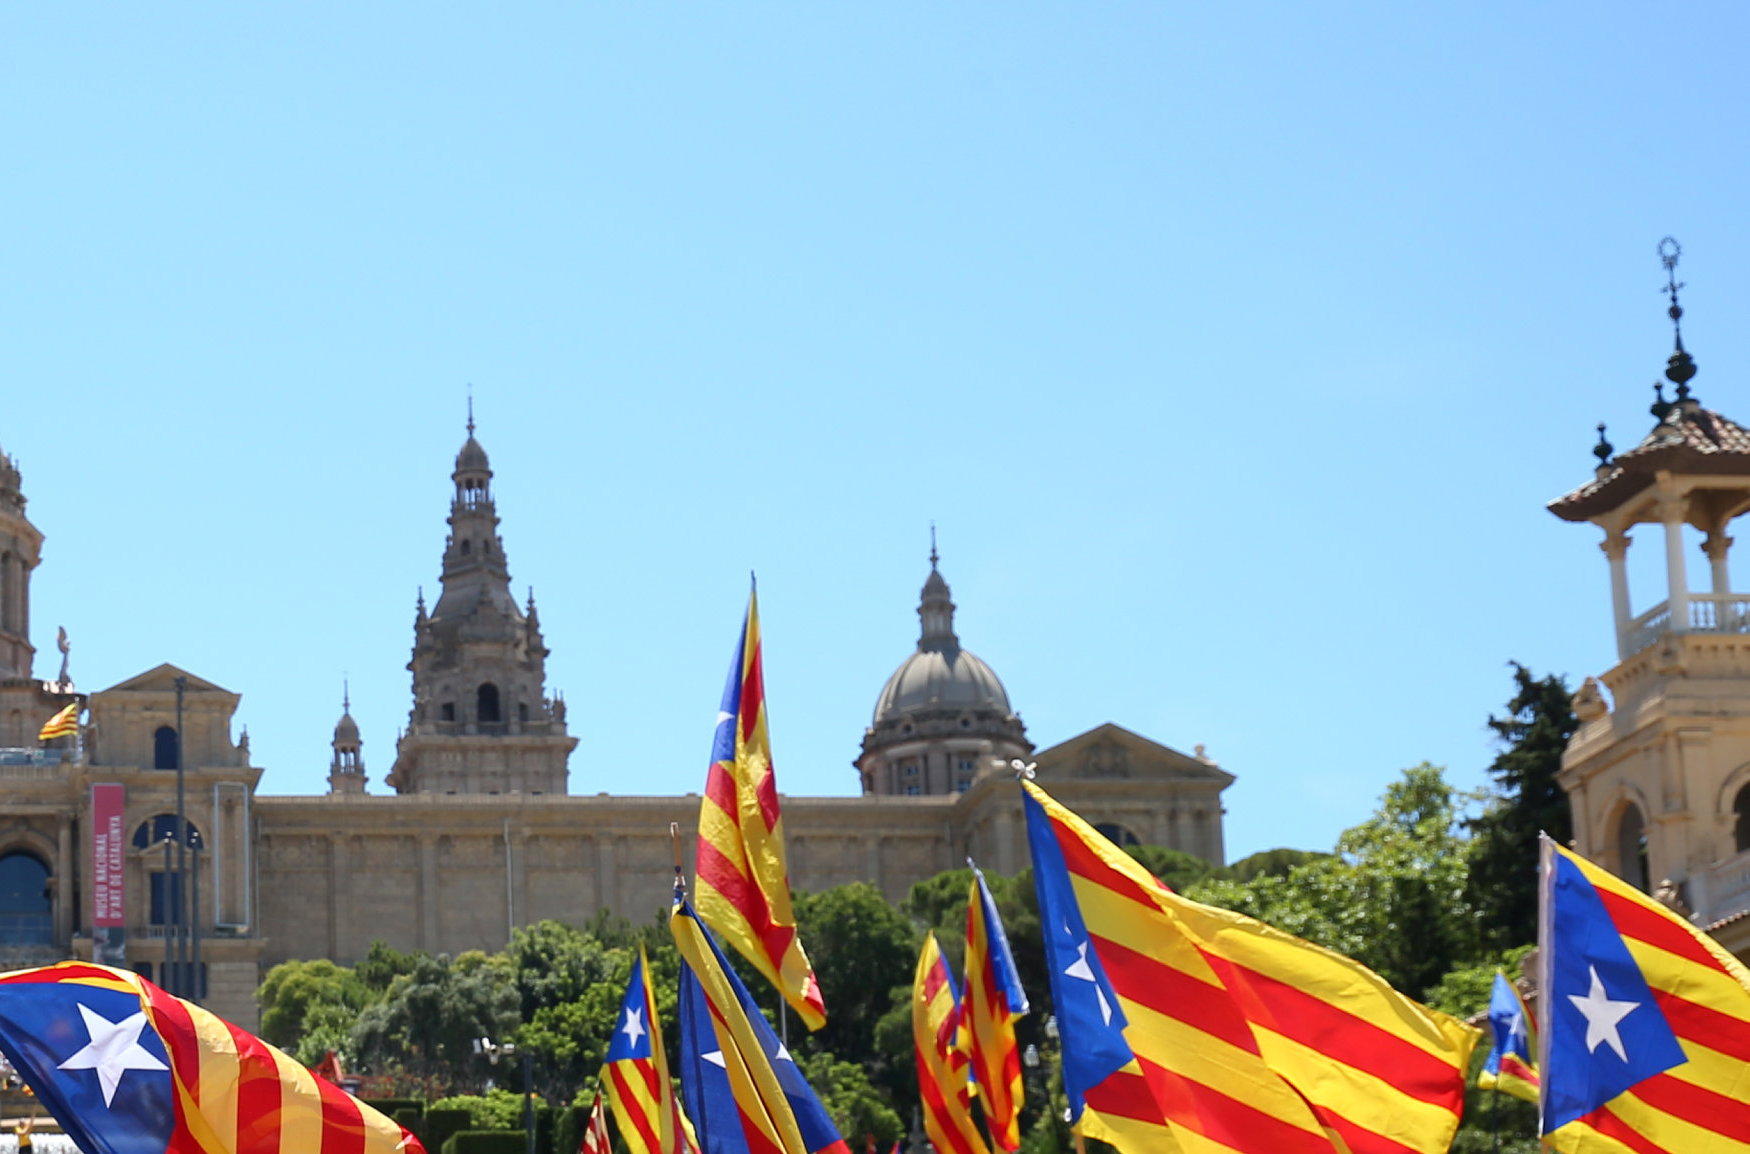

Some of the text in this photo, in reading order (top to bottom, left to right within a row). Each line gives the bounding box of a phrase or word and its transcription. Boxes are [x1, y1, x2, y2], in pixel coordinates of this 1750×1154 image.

[109, 815, 122, 871] CATALUNYA
[95, 833, 107, 919] MUSEU NACIONAL
[109, 874, 122, 887] DE
